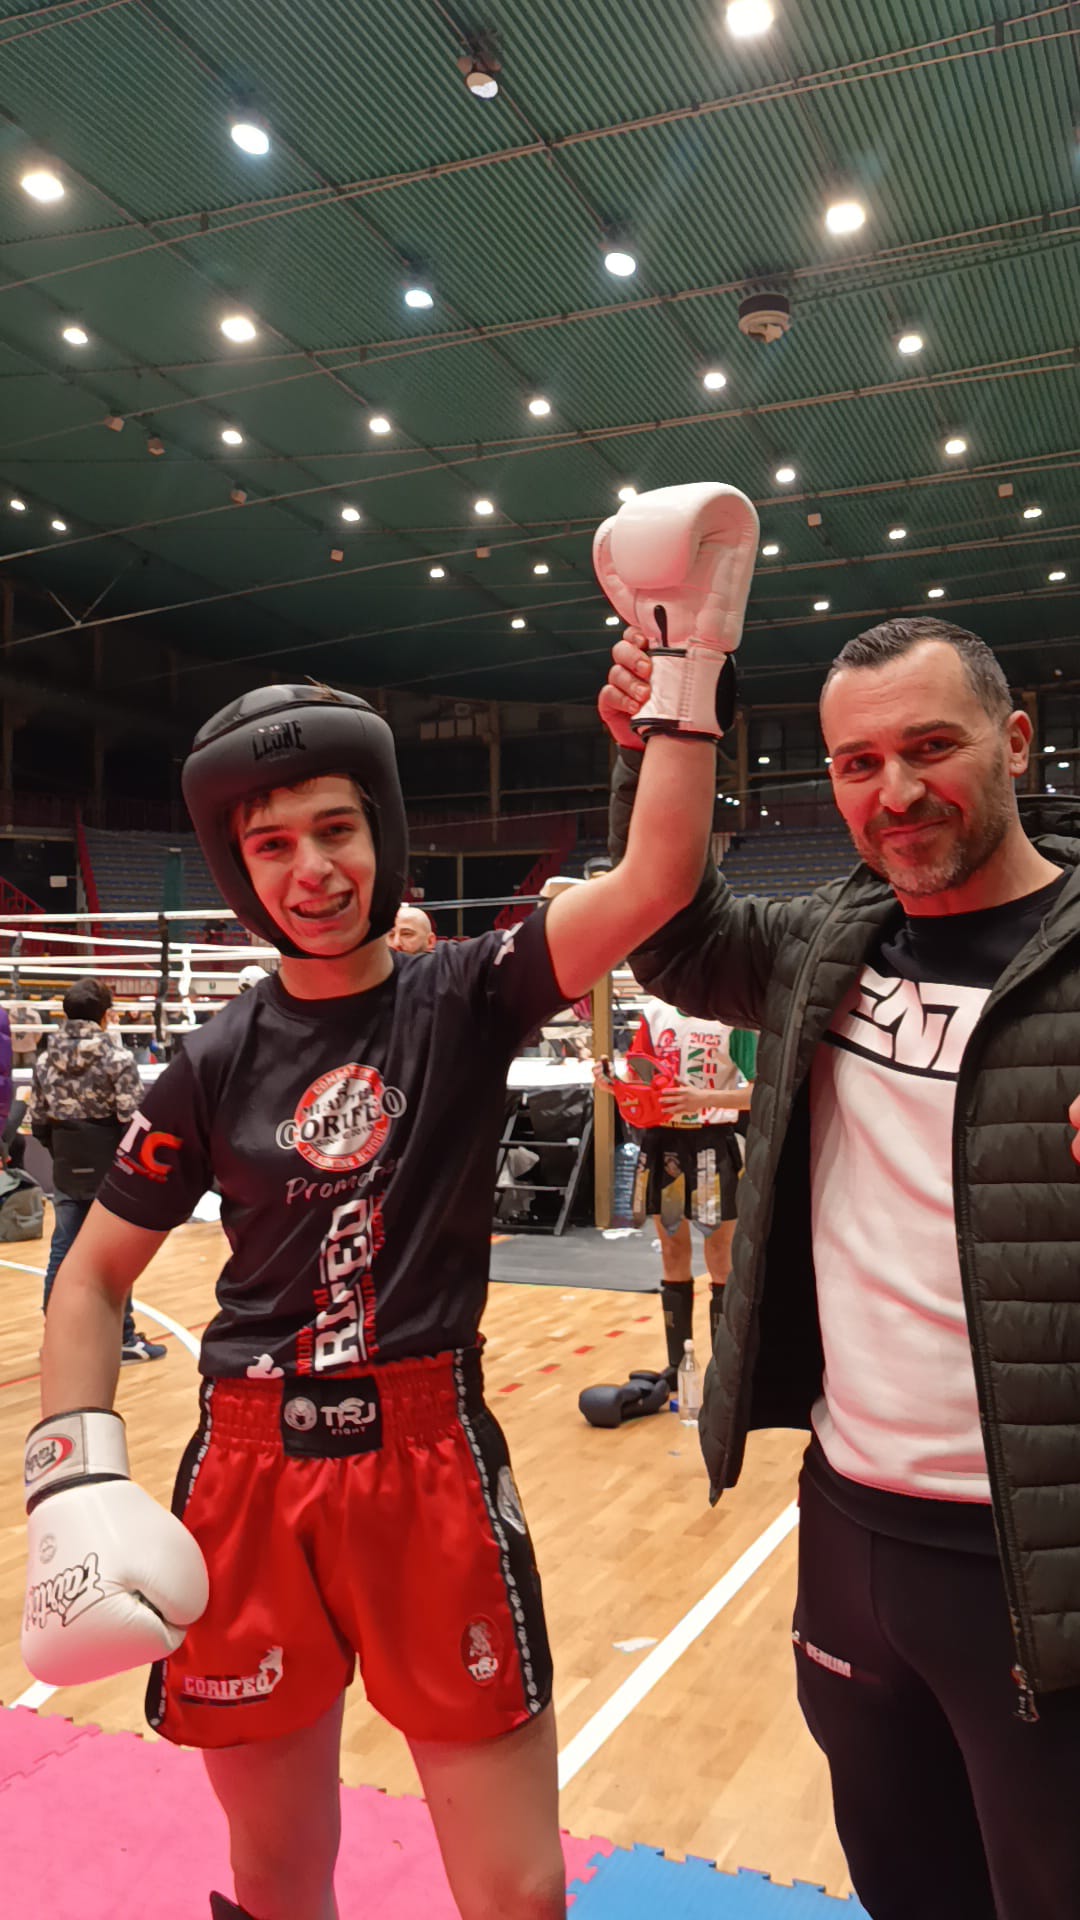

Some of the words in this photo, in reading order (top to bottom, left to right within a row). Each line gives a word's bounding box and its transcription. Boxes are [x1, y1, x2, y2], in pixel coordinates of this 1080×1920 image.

[688, 1032, 721, 1047] 2025
[275, 1086, 407, 1149] CORIFEO
[360, 1273, 380, 1357] TRAININ
[183, 1674, 270, 1700] CORIFEO
